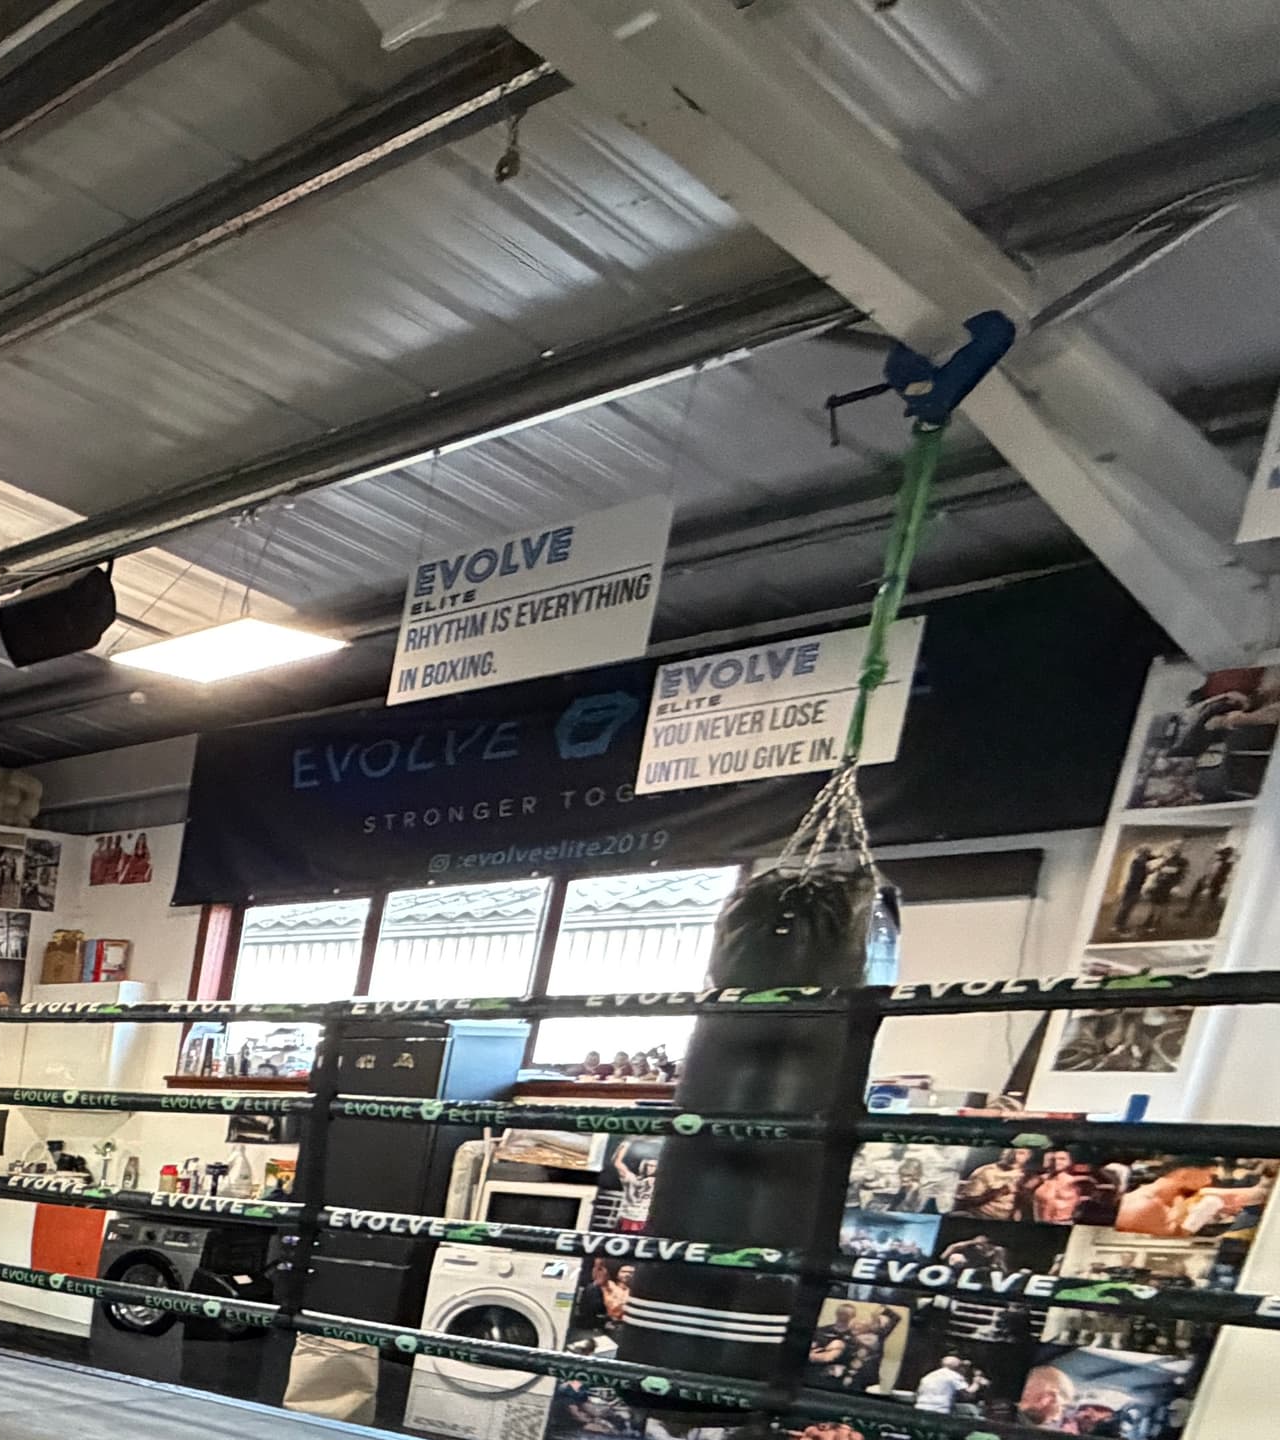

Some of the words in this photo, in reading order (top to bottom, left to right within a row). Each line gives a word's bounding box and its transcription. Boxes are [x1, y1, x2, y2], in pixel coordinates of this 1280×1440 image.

[413, 526, 575, 598] EVOLVE
[405, 612, 487, 653] RHYTHM
[490, 606, 510, 634] IS
[515, 573, 653, 628] EVERYTHING
[410, 589, 477, 616] ELITE
[397, 667, 417, 693] IN
[421, 651, 498, 689] BOXING.
[660, 642, 820, 699] EVOLVE
[656, 694, 721, 716] ELITE
[652, 721, 692, 749] YOU
[694, 709, 765, 743] NEVER
[769, 700, 829, 731] LOSE
[292, 720, 520, 789] EVOLVE
[645, 753, 700, 785] UNTIL
[708, 750, 749, 776] YOU
[752, 741, 805, 770] GIVE
[809, 736, 838, 763] IN.
[362, 795, 538, 834] STRONGER
[586, 987, 743, 1007] EVOLVE
[891, 975, 1103, 1001] EVOLVE
[21, 1000, 100, 1014] EVOLVE
[350, 998, 473, 1016] EVOLVE
[13, 1090, 59, 1104] EVOLVE
[80, 1092, 119, 1106] ELITE
[160, 1096, 217, 1110] EVOLVE
[243, 1098, 292, 1112] ELITE
[344, 1102, 413, 1119] EVOLVE
[448, 1108, 508, 1125] ELITE
[576, 1115, 666, 1133] EVOLVE
[711, 1122, 789, 1139] ELITE
[7, 1175, 87, 1195] EVOLVE
[151, 1191, 244, 1214] EVOLVE
[330, 1210, 446, 1238] EVOLVE
[555, 1232, 710, 1263] EVOLVE
[1, 1267, 45, 1287] EVOLVE
[66, 1282, 105, 1298] ELITE
[851, 1257, 1060, 1298] EVOLVE
[144, 1294, 200, 1315] EVOLVE
[225, 1309, 274, 1326] ELITE
